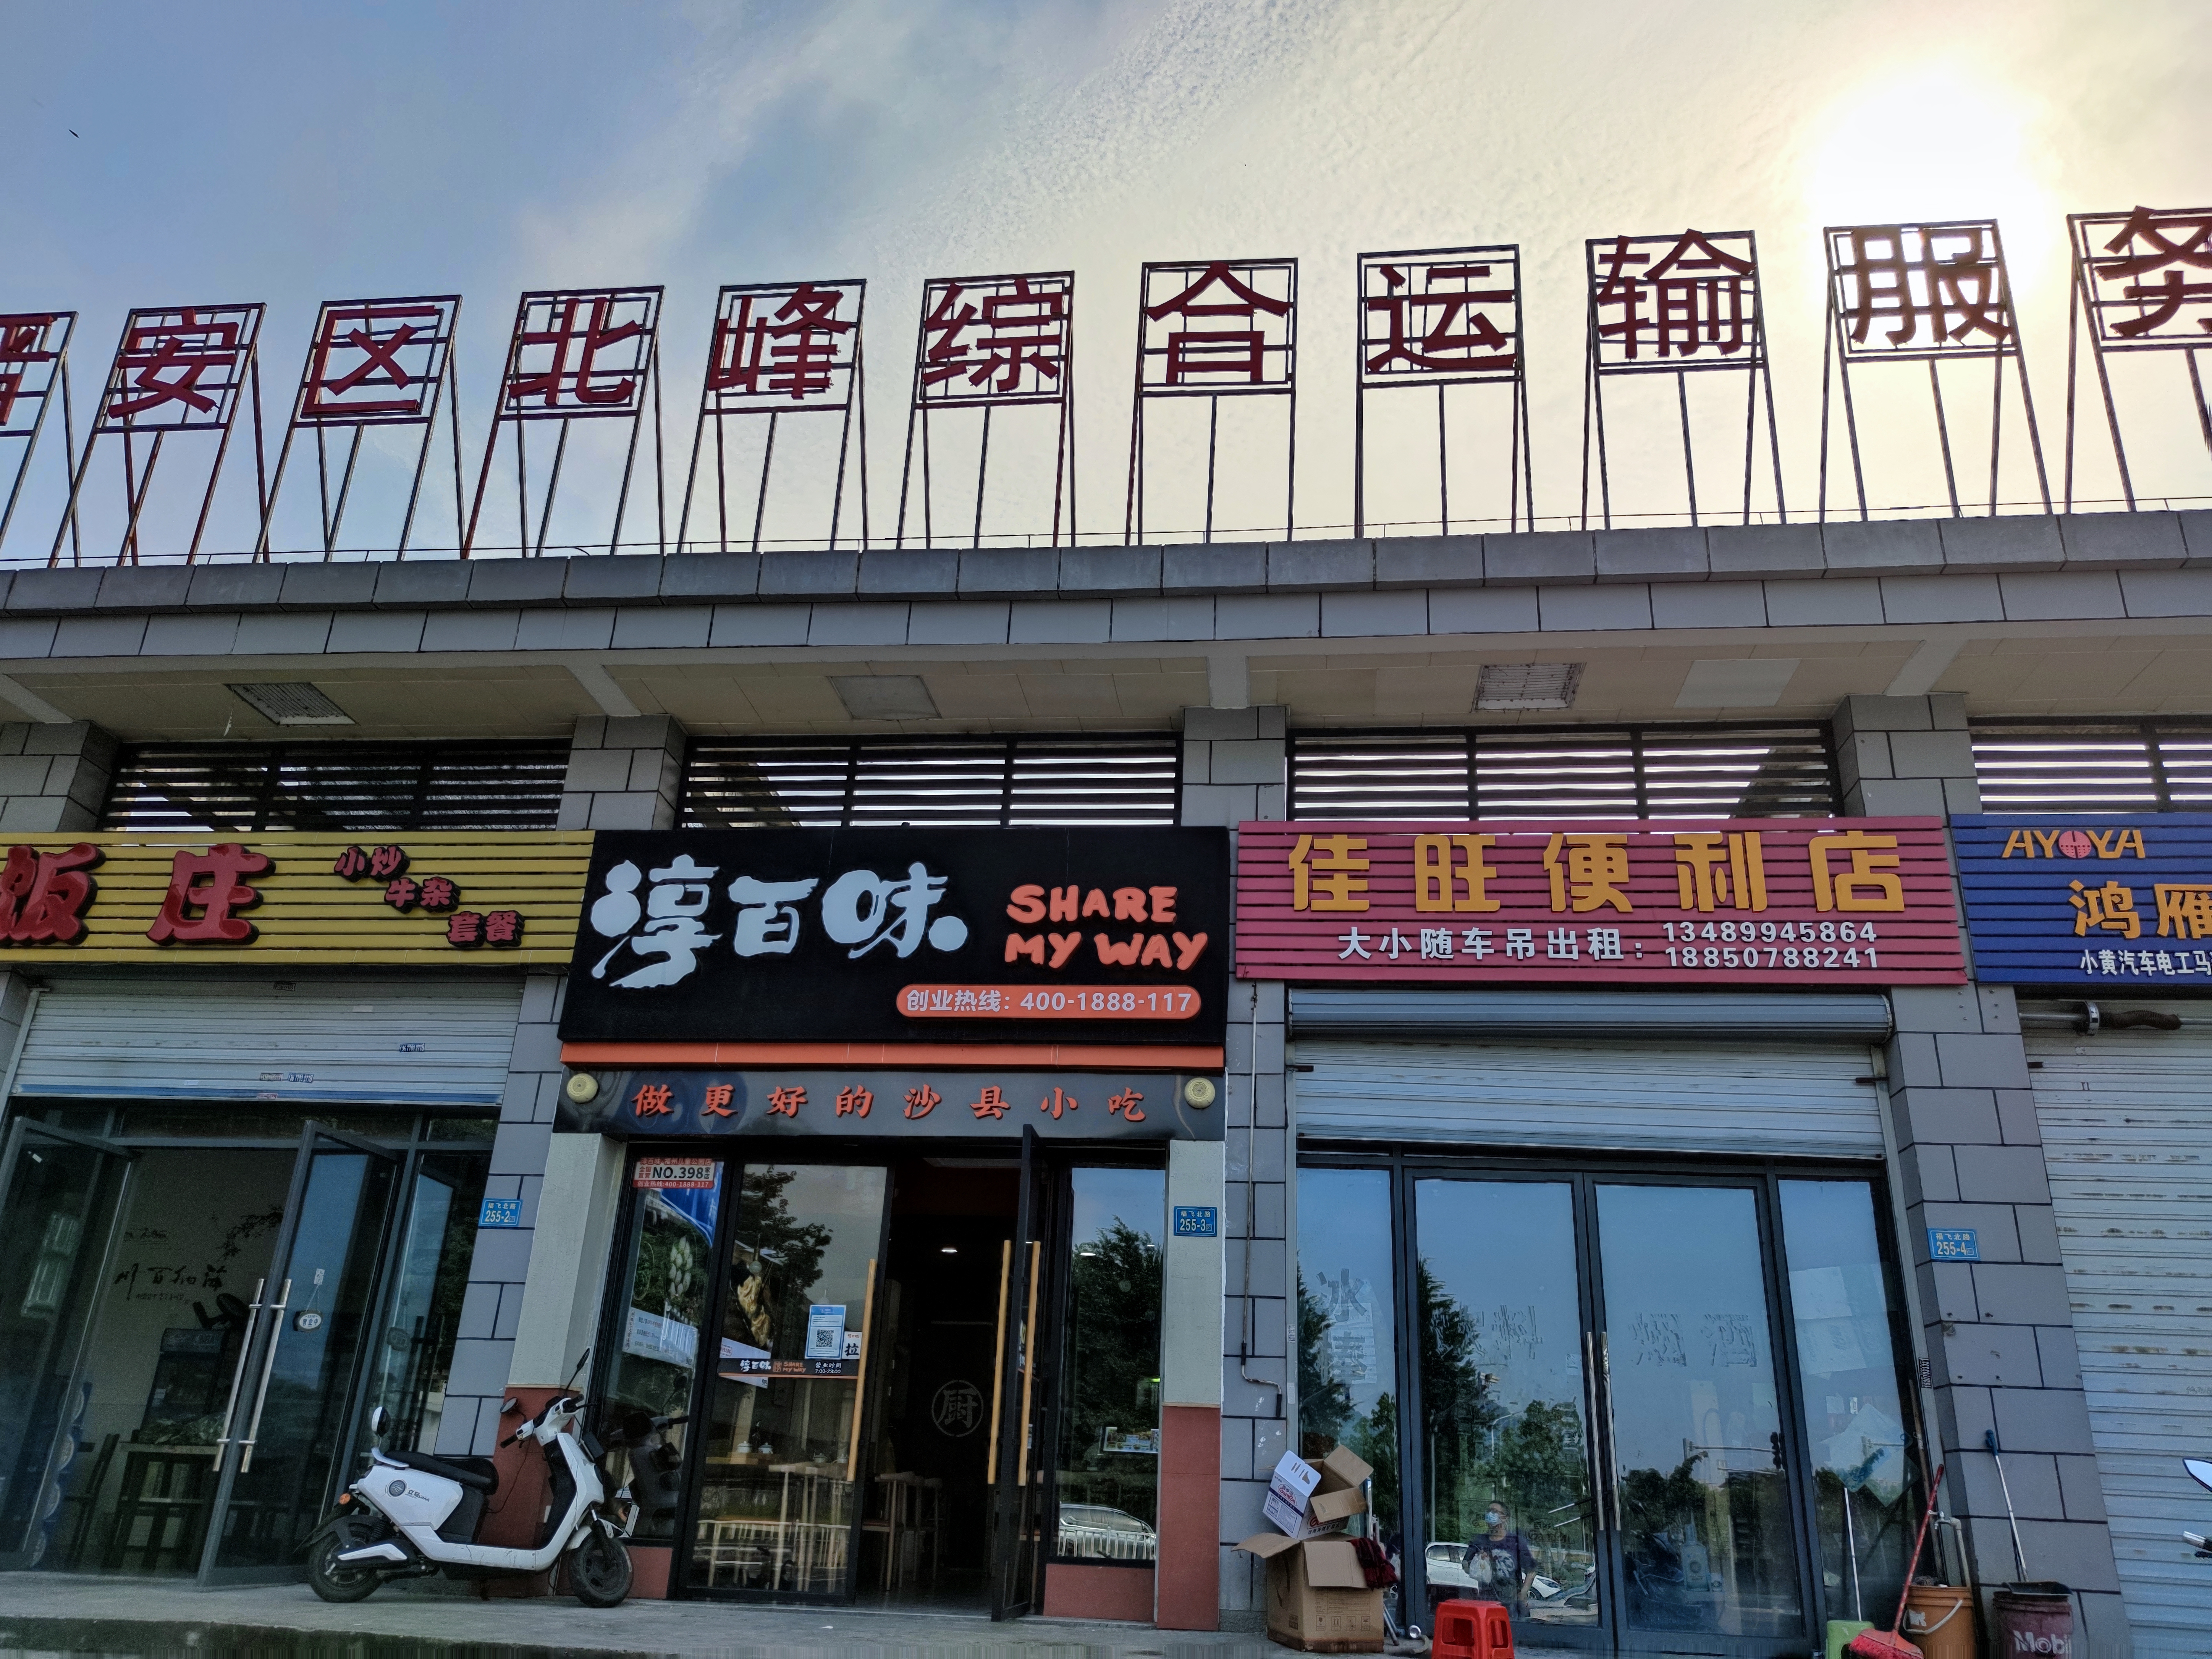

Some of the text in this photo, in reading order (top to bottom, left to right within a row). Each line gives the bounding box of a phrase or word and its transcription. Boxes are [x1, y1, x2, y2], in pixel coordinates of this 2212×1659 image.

[334, 845, 405, 878] 小炒
[1288, 830, 1905, 913] 佳旺便利店
[0, 842, 270, 941] 饭庄
[385, 878, 454, 908] 牛杂
[1006, 884, 1179, 924] SHARE
[447, 911, 517, 942] 套餐
[590, 854, 968, 988] 淳百味
[1662, 921, 1878, 944] 13489945864
[1004, 931, 1209, 971] MY WAY
[1664, 947, 1879, 969] 18850788241
[2080, 949, 2212, 977] 小黄汽车电工马
[632, 1083, 1147, 1122] 做更好的沙县小吃
[652, 1167, 703, 1179] NO.398
[484, 1210, 510, 1222] 255-2
[1180, 1210, 1211, 1218] 福飞北路
[1180, 1218, 1206, 1232] 255-3
[1936, 1233, 1970, 1241] 福飞北路
[1936, 1241, 1967, 1256] 255-4
[844, 1343, 859, 1357] 拉
[740, 1360, 771, 1372] 淳百味
[1282, 1485, 1294, 1496] 百岁山
